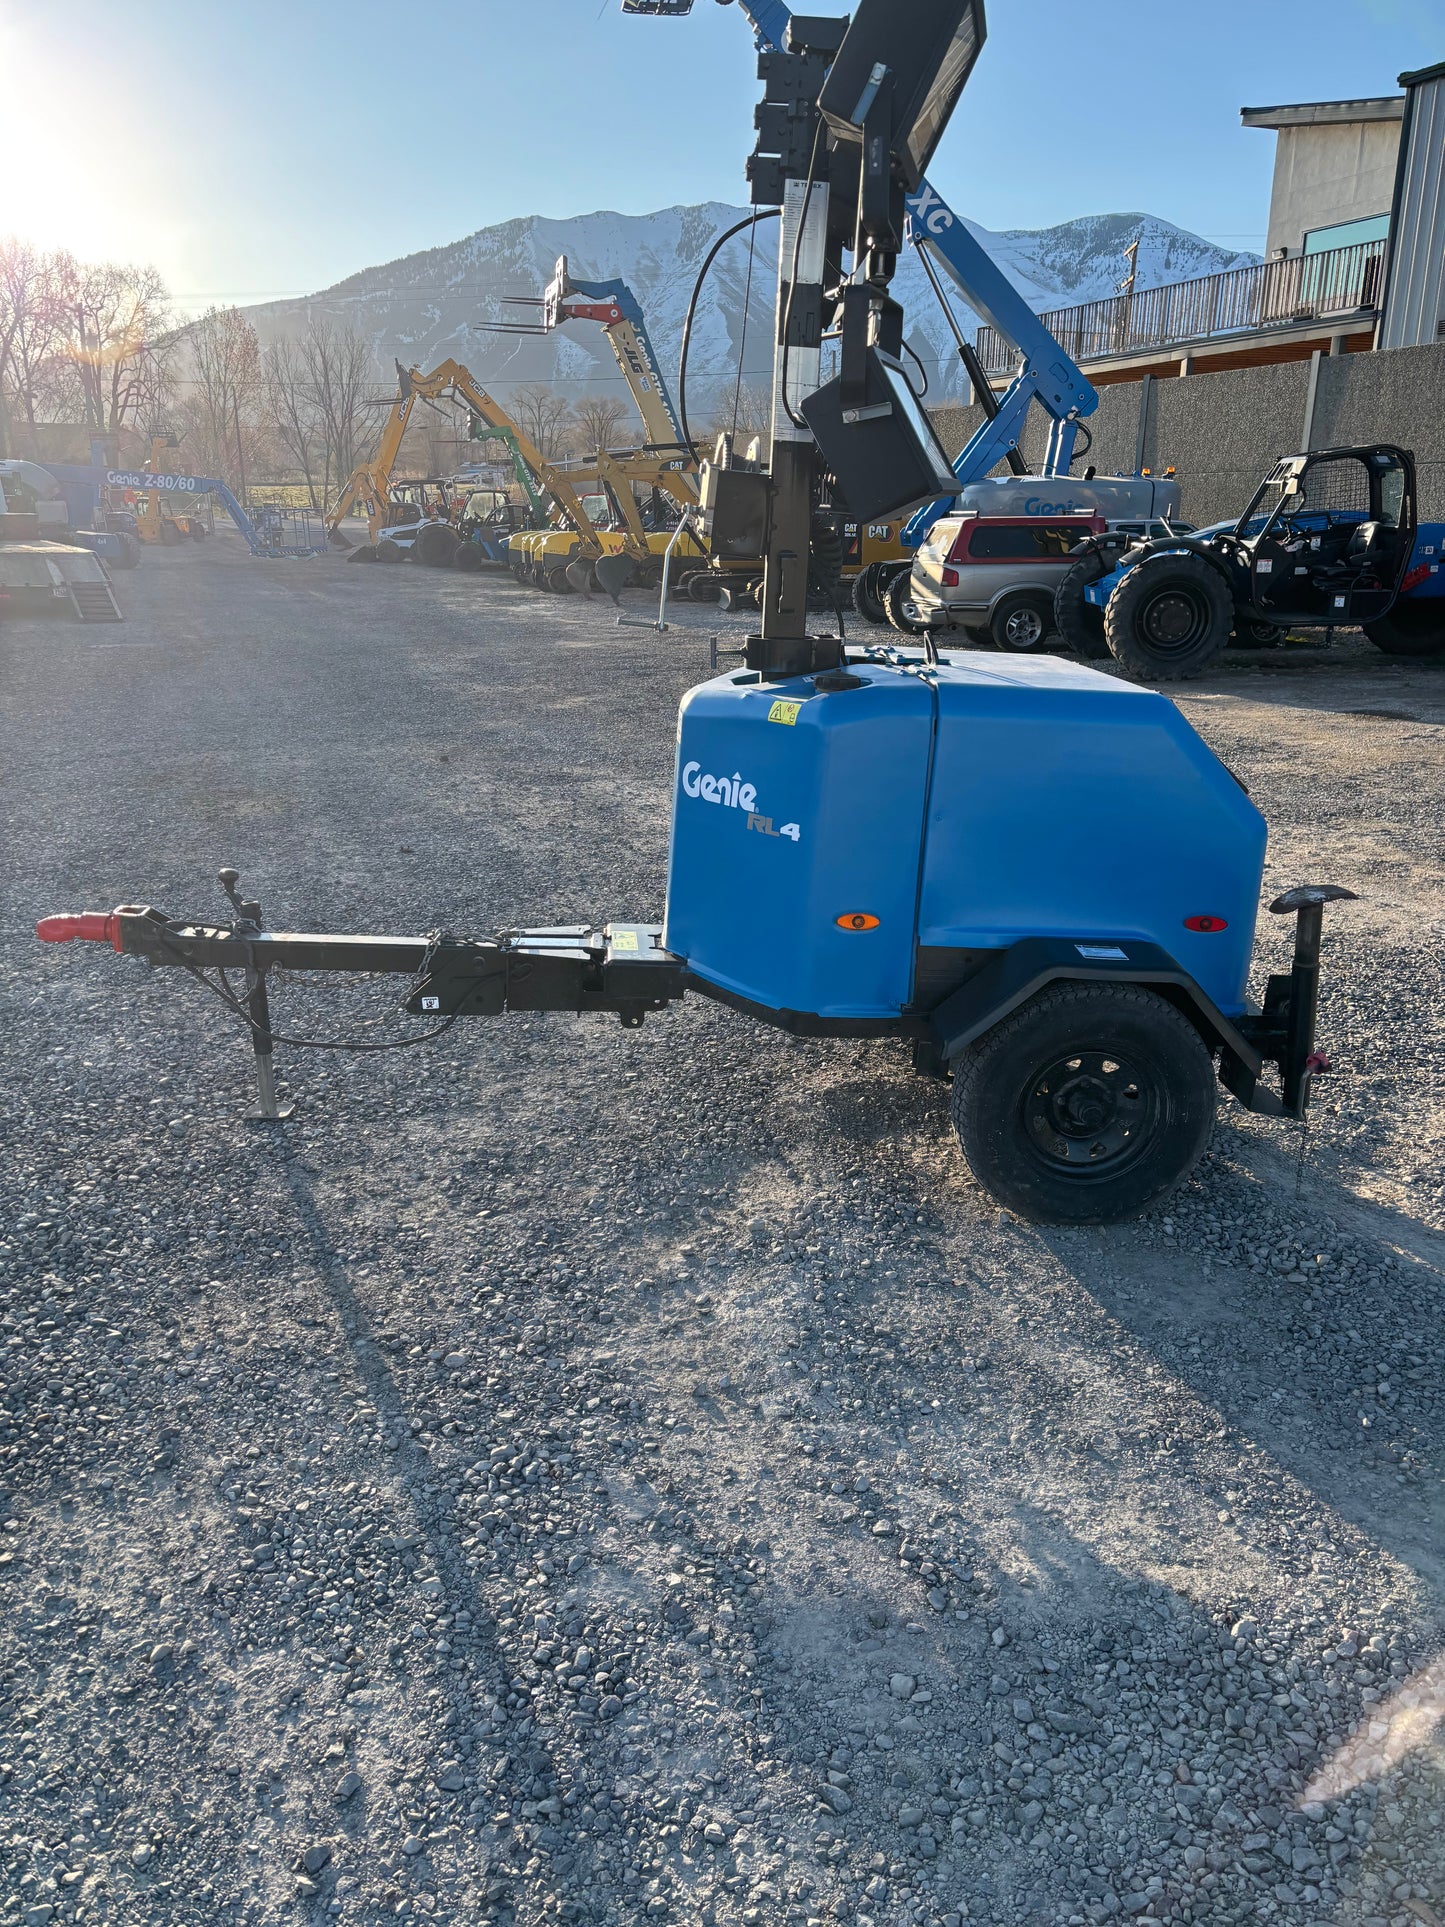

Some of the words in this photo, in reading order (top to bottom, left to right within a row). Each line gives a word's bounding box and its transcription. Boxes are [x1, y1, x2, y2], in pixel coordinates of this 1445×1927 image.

[906, 185, 953, 234] XC
[623, 346, 644, 374] JLG
[468, 379, 487, 399] JCB
[669, 461, 684, 471] CAT
[107, 471, 141, 486] Genie
[144, 474, 196, 491] Z-80/60
[844, 523, 858, 532] CAT
[868, 525, 889, 539] CAT
[682, 761, 758, 813] Genie
[746, 812, 801, 842] RL4
